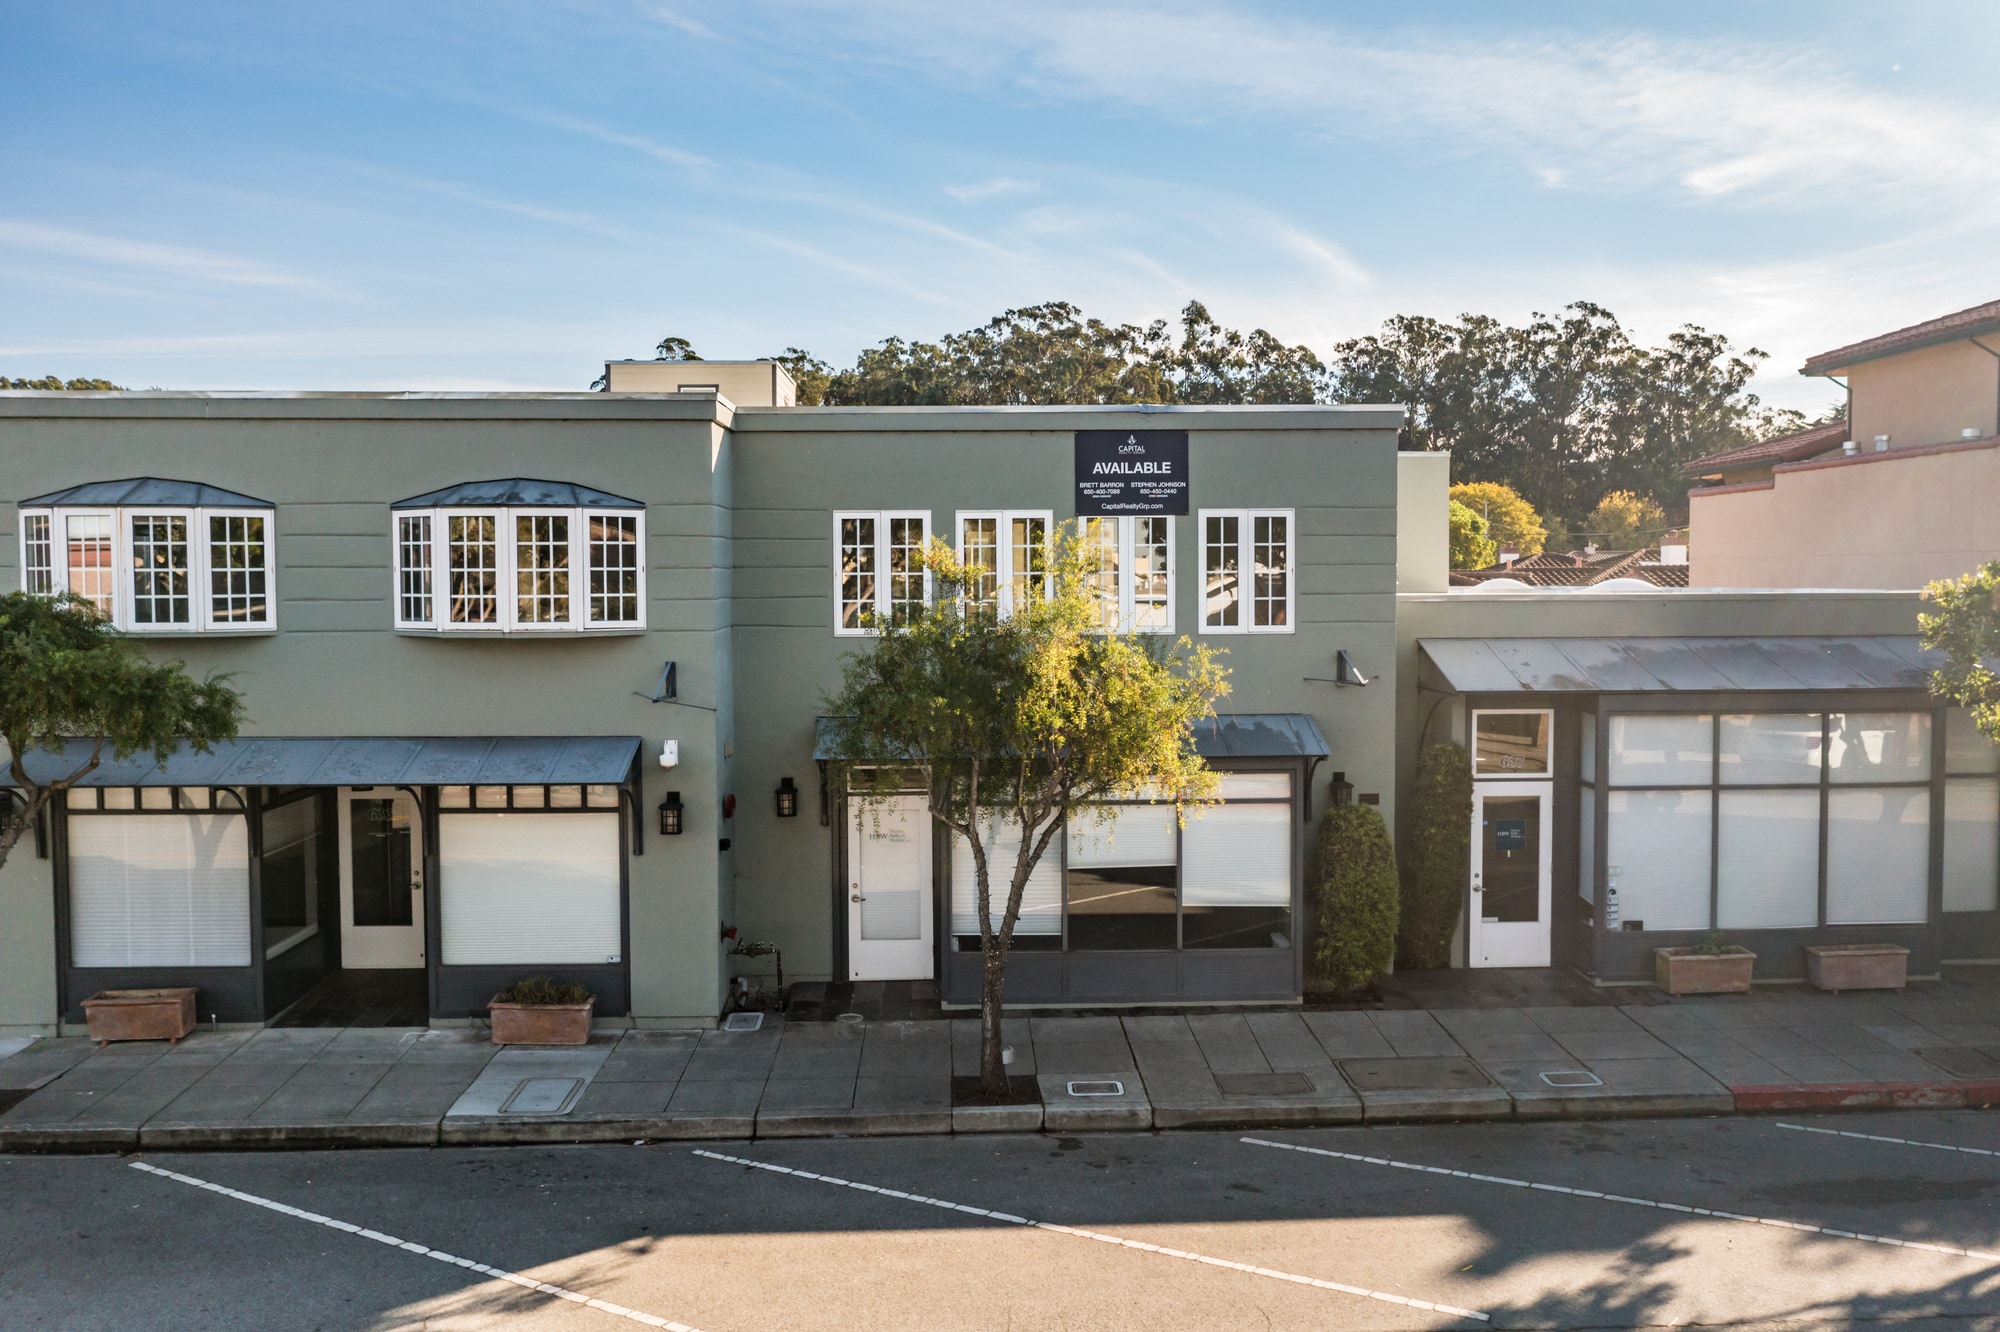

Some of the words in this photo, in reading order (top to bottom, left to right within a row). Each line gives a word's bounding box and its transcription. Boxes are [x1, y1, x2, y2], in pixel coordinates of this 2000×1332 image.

[1092, 461, 1172, 474] AVAILABLE
[1101, 502, 1164, 511] CapitalRealtyGrp.com
[1500, 755, 1525, 768] 637
